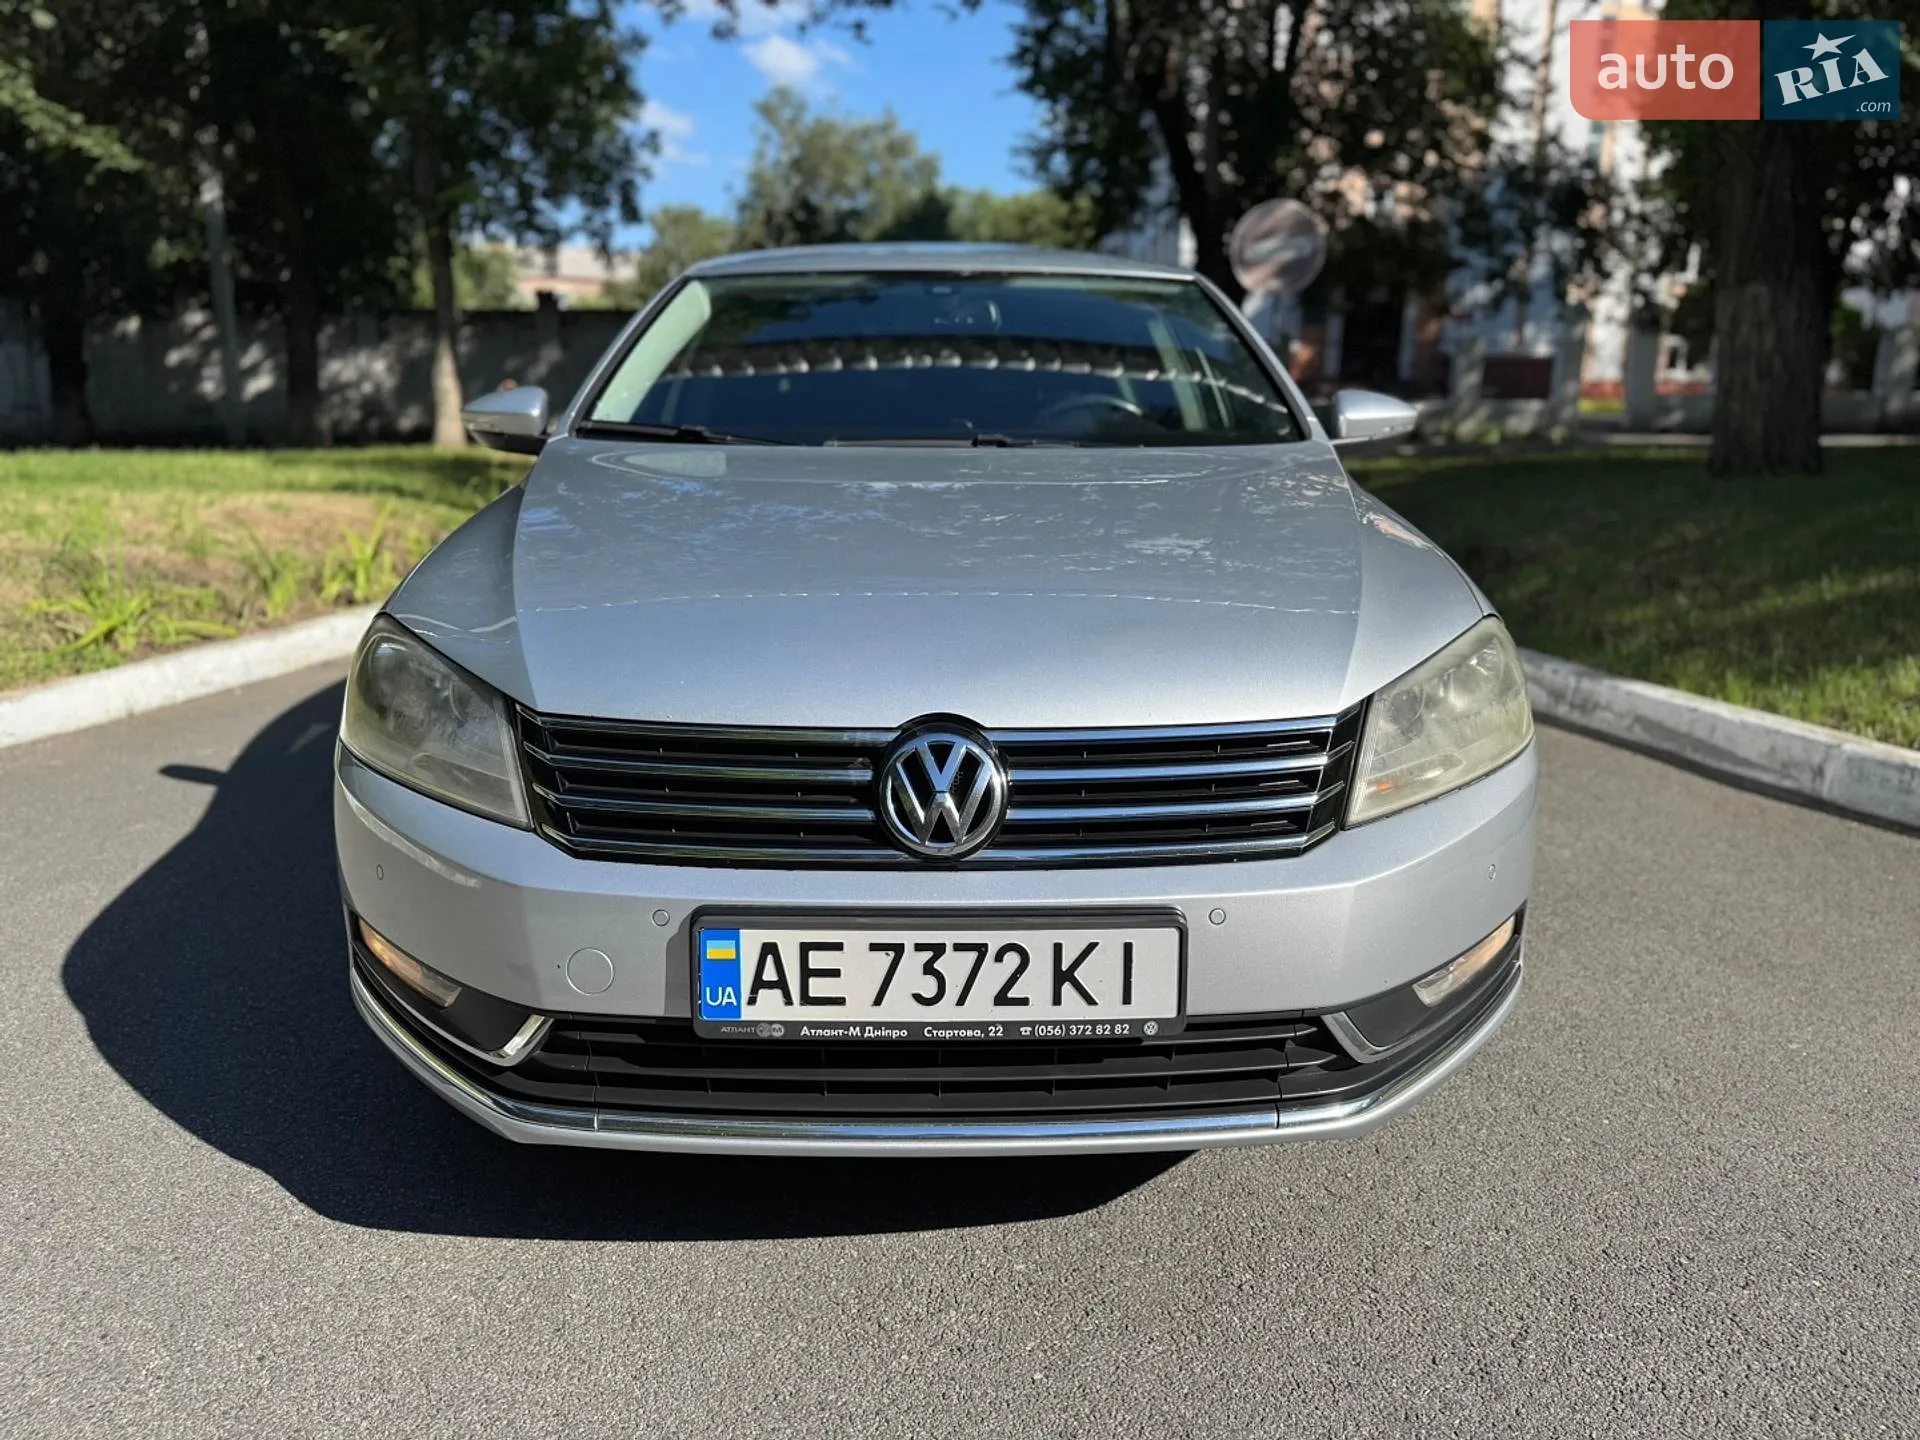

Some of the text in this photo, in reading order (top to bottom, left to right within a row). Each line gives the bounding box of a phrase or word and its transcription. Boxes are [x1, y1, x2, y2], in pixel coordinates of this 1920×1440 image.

[746, 941, 847, 1006] AE
[868, 942, 1031, 1007] 7372
[706, 986, 738, 1006] UA
[800, 1025, 908, 1039] Атлант-М Дніпро
[923, 1025, 1004, 1039] Стартова, 22
[1034, 1023, 1130, 1037] (056) 372 82 82
